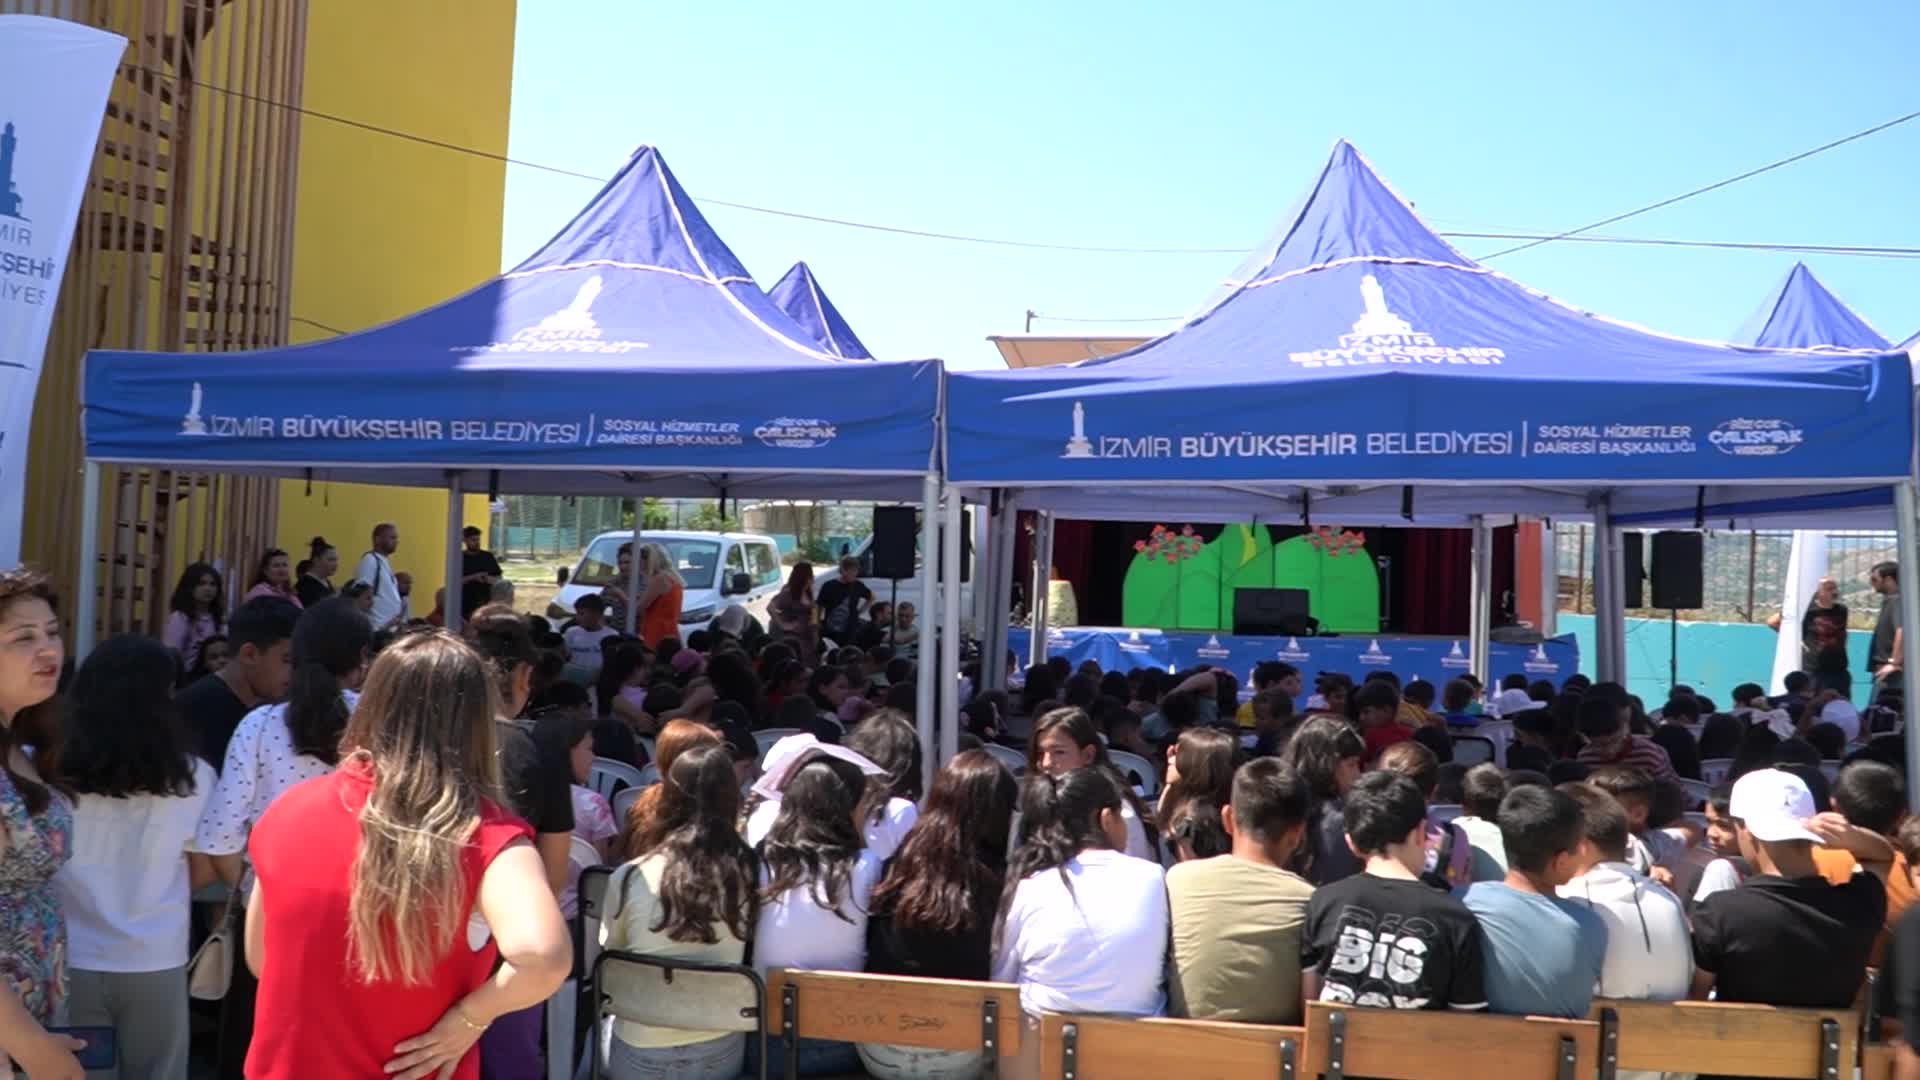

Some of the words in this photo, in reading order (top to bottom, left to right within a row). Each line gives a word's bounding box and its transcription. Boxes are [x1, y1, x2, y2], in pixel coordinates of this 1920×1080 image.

[211, 414, 275, 437] İZMİR
[282, 414, 443, 440] BÜYÜKŞEHİR
[451, 419, 580, 444] BELEDİYESİ
[603, 419, 658, 432] SOSYAL
[1538, 425, 1600, 438] SOSYAL
[1603, 423, 1692, 438] HİZMETLER
[1099, 434, 1171, 458] İZMİR
[1180, 431, 1358, 460] BÜYÜKŞEHİR
[1367, 430, 1513, 454] BELEDİYESİ
[1533, 439, 1597, 454] DAİRESİ
[1599, 440, 1696, 456] BAŞKANLIĞI
[1330, 925, 1428, 984] BIG
